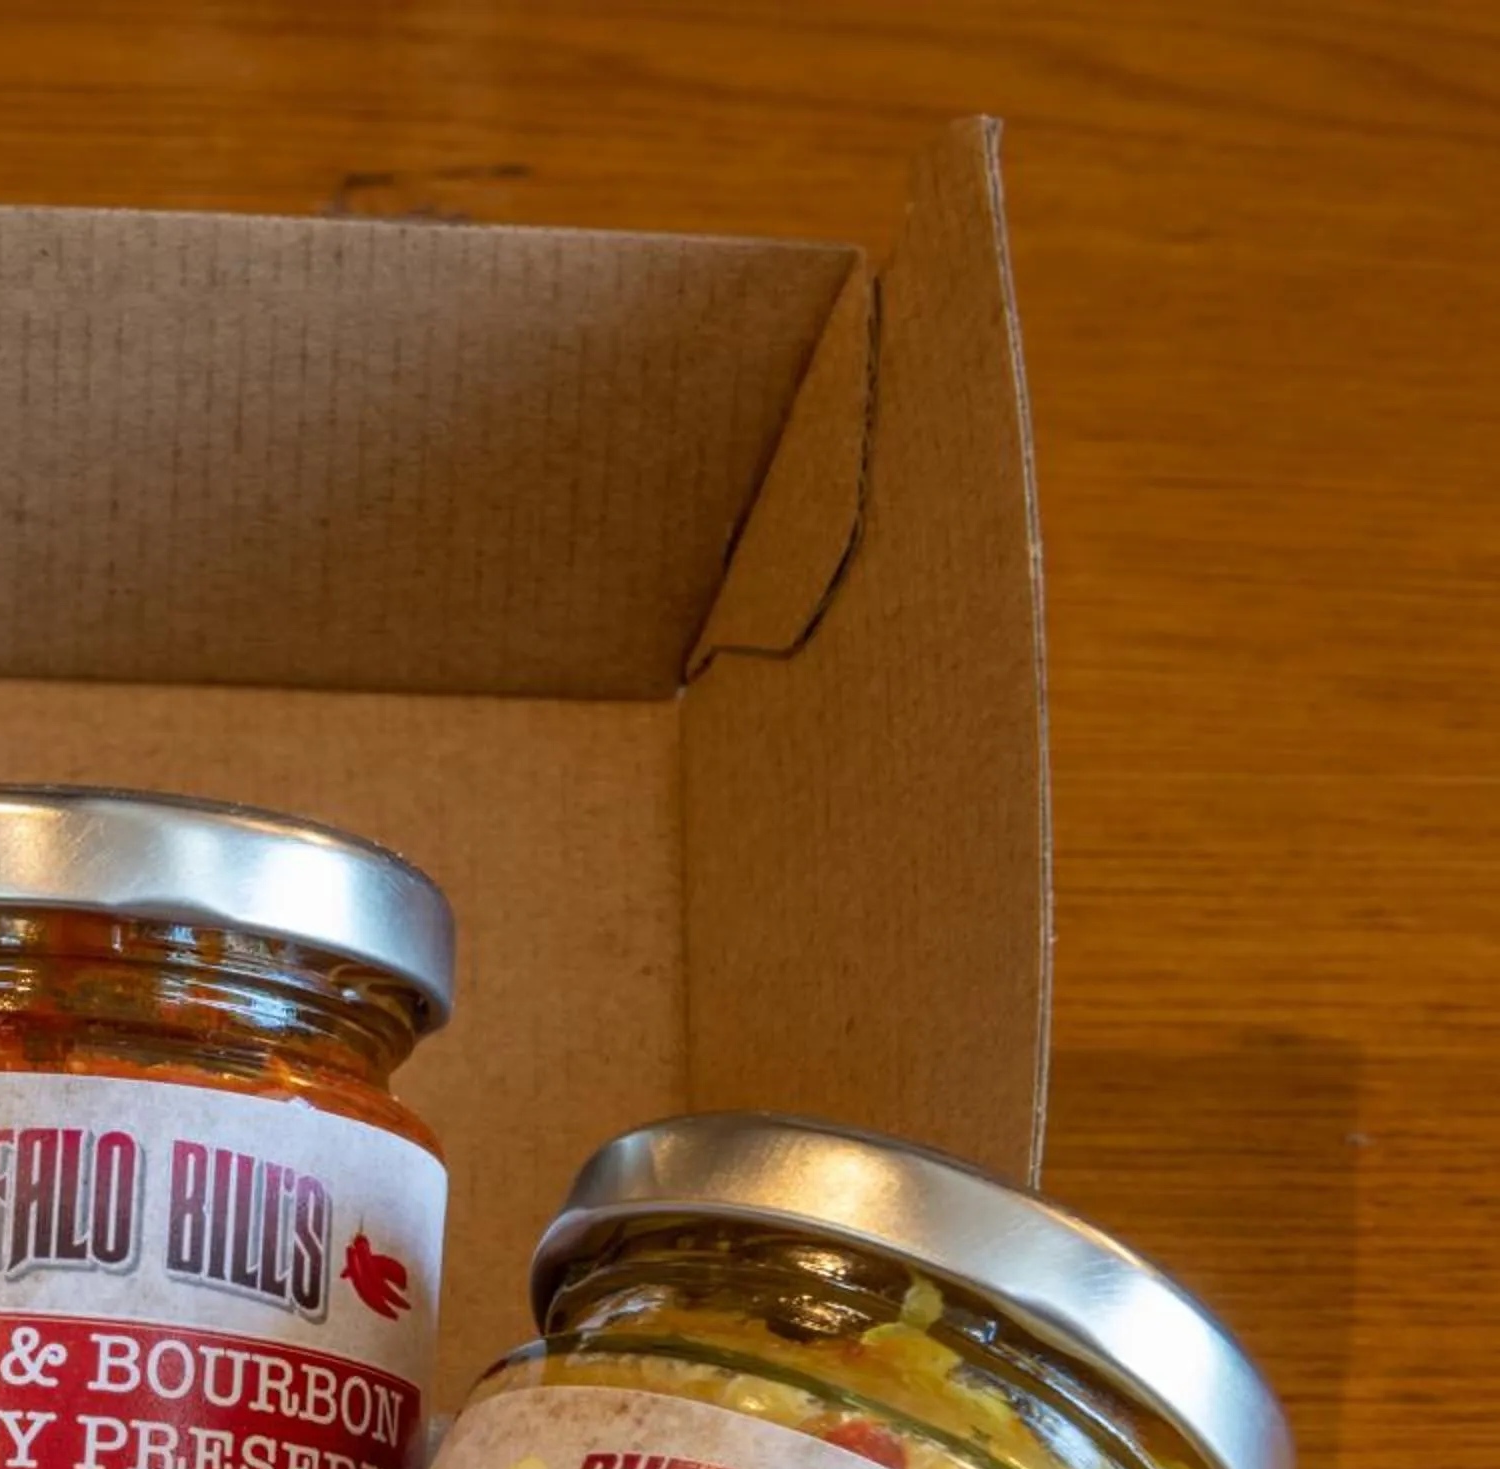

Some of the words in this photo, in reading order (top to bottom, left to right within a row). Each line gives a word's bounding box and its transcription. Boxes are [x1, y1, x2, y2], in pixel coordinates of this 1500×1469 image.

[167, 1139, 332, 1320] BILL'S
[0, 1327, 66, 1387] &
[87, 1332, 404, 1448] BOURBON
